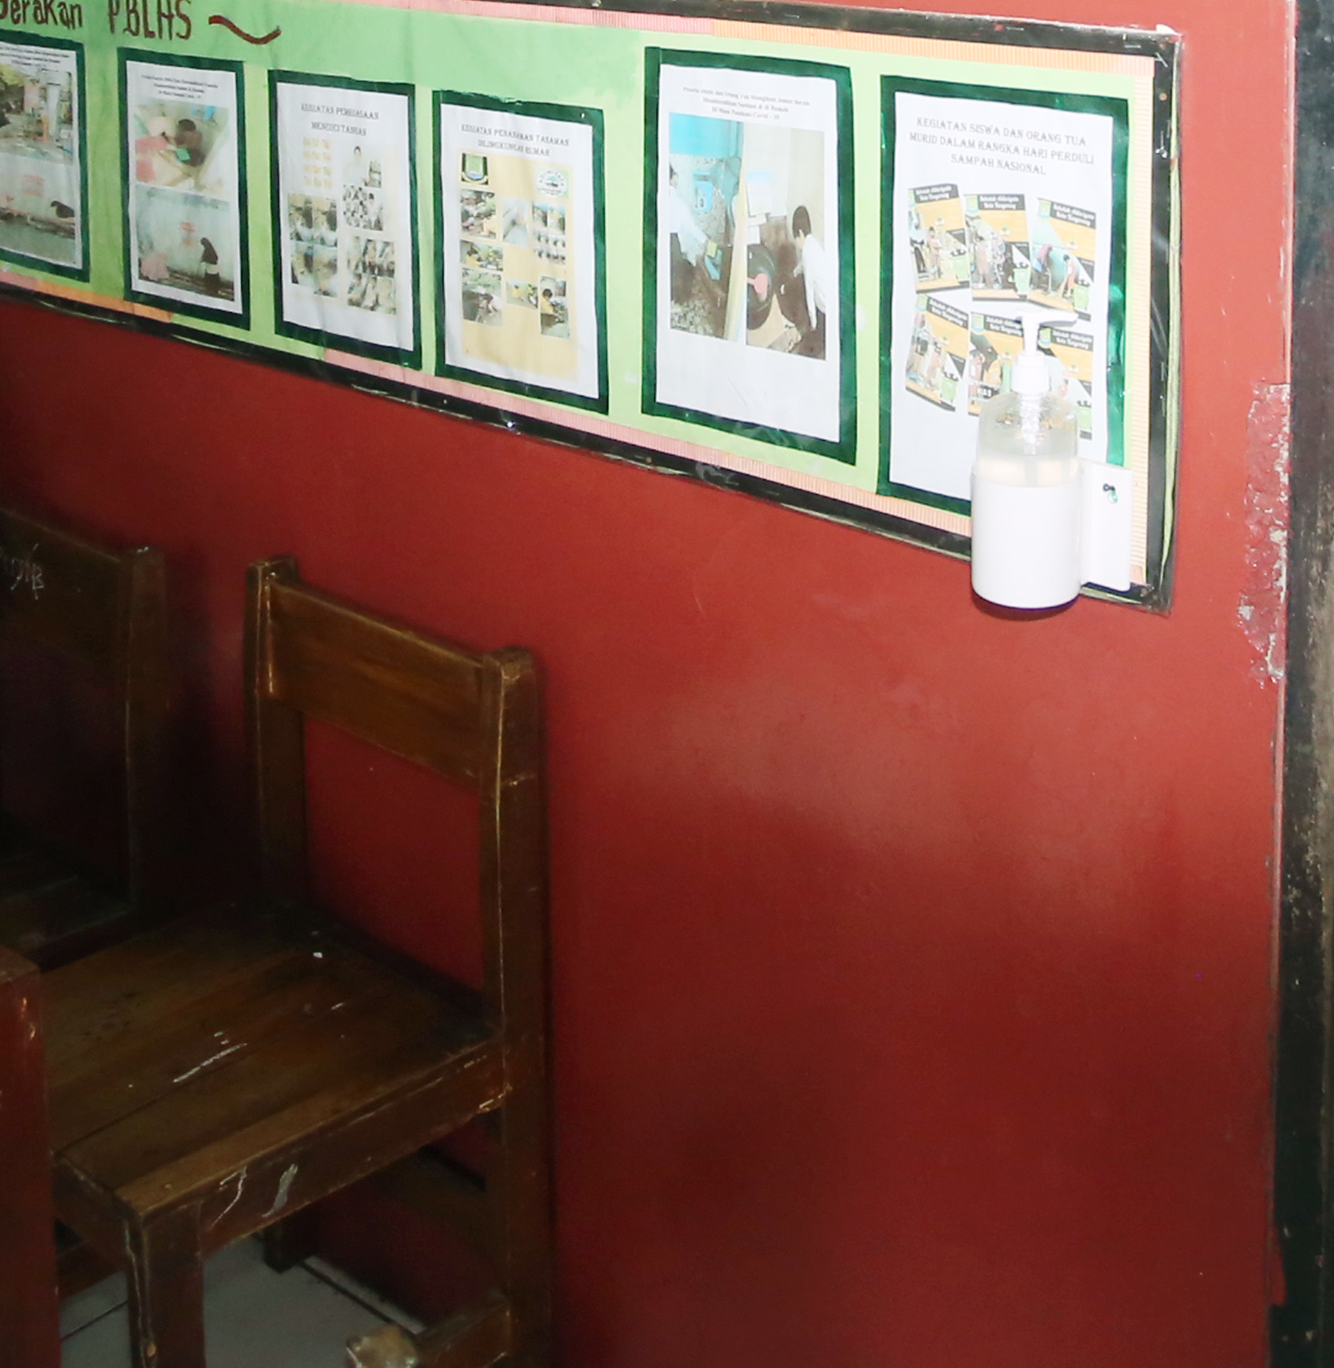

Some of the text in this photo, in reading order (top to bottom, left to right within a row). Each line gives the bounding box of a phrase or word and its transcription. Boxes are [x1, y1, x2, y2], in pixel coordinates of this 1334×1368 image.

[917, 116, 1087, 146] KEGIATAN SISWA DAN ORANG TUA
[909, 132, 1095, 165] MURID DALAM RANGKA HARI PERDULI
[951, 153, 1047, 175] SAMPAH NASIONAL
